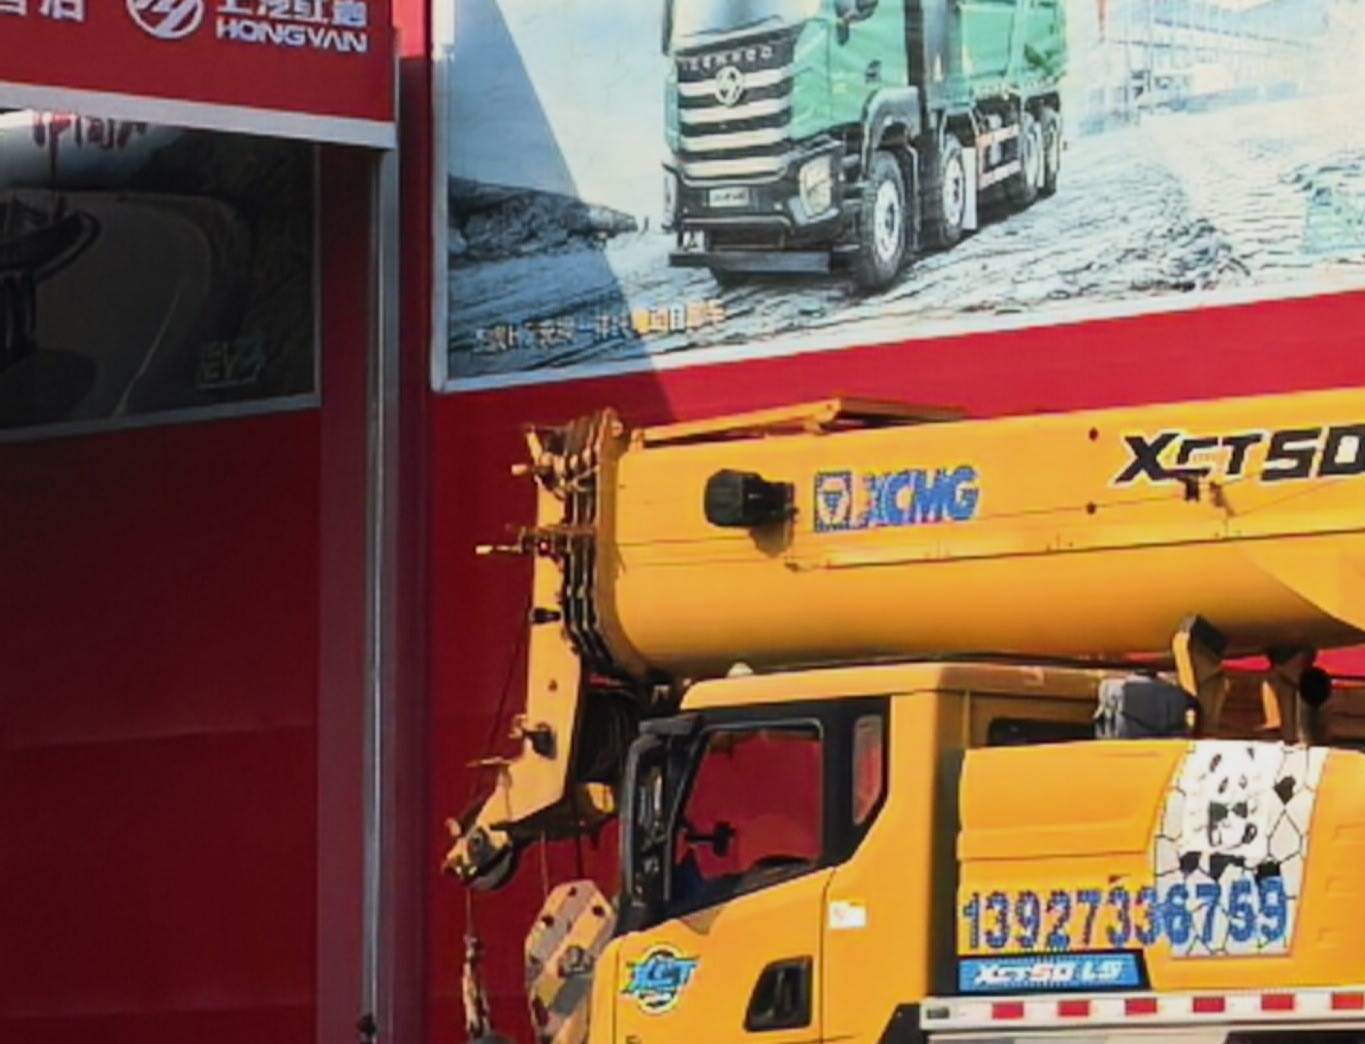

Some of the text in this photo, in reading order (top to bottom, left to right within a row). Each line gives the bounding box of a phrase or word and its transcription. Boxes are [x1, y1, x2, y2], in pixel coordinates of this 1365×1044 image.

[216, 17, 368, 52] HONGYAN
[859, 464, 979, 525] XCMG
[962, 874, 1289, 950] 13927336759
